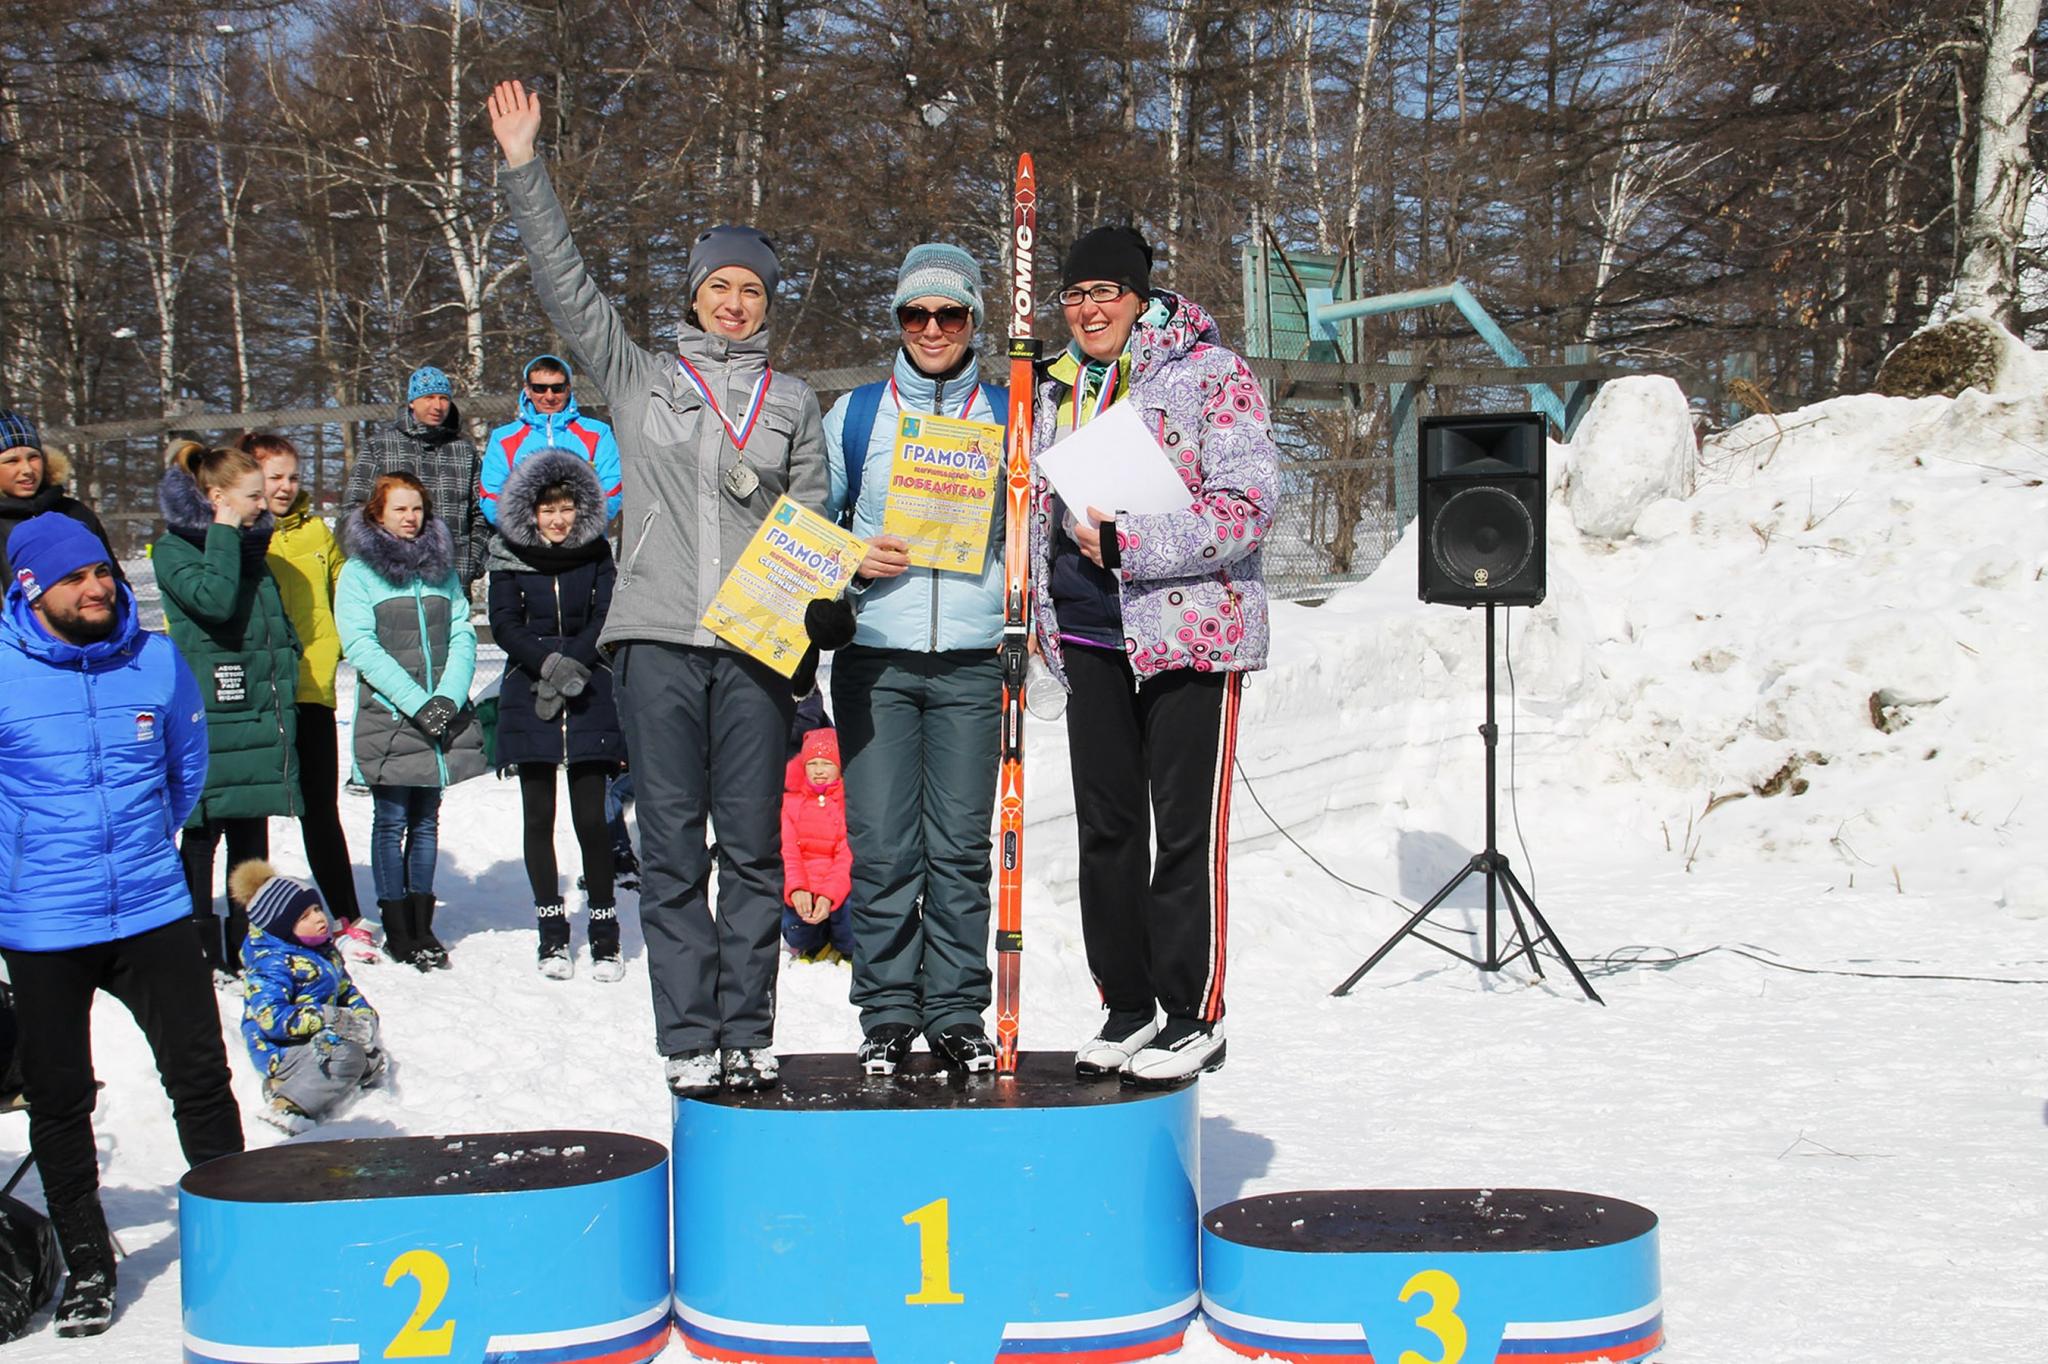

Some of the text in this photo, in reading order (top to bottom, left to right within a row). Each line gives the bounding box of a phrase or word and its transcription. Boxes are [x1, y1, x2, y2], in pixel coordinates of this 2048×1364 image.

[1014, 224, 1033, 339] TOMIC
[892, 475, 987, 500] ПОБЕДИТЕЛЬ
[903, 443, 988, 472] ГРАМОТА
[766, 527, 841, 582] ГРАМОТА
[766, 574, 799, 594] ПРИЗЕР
[902, 1198, 964, 1304] 1
[383, 1249, 456, 1358] 2
[1398, 1269, 1467, 1364] 3
